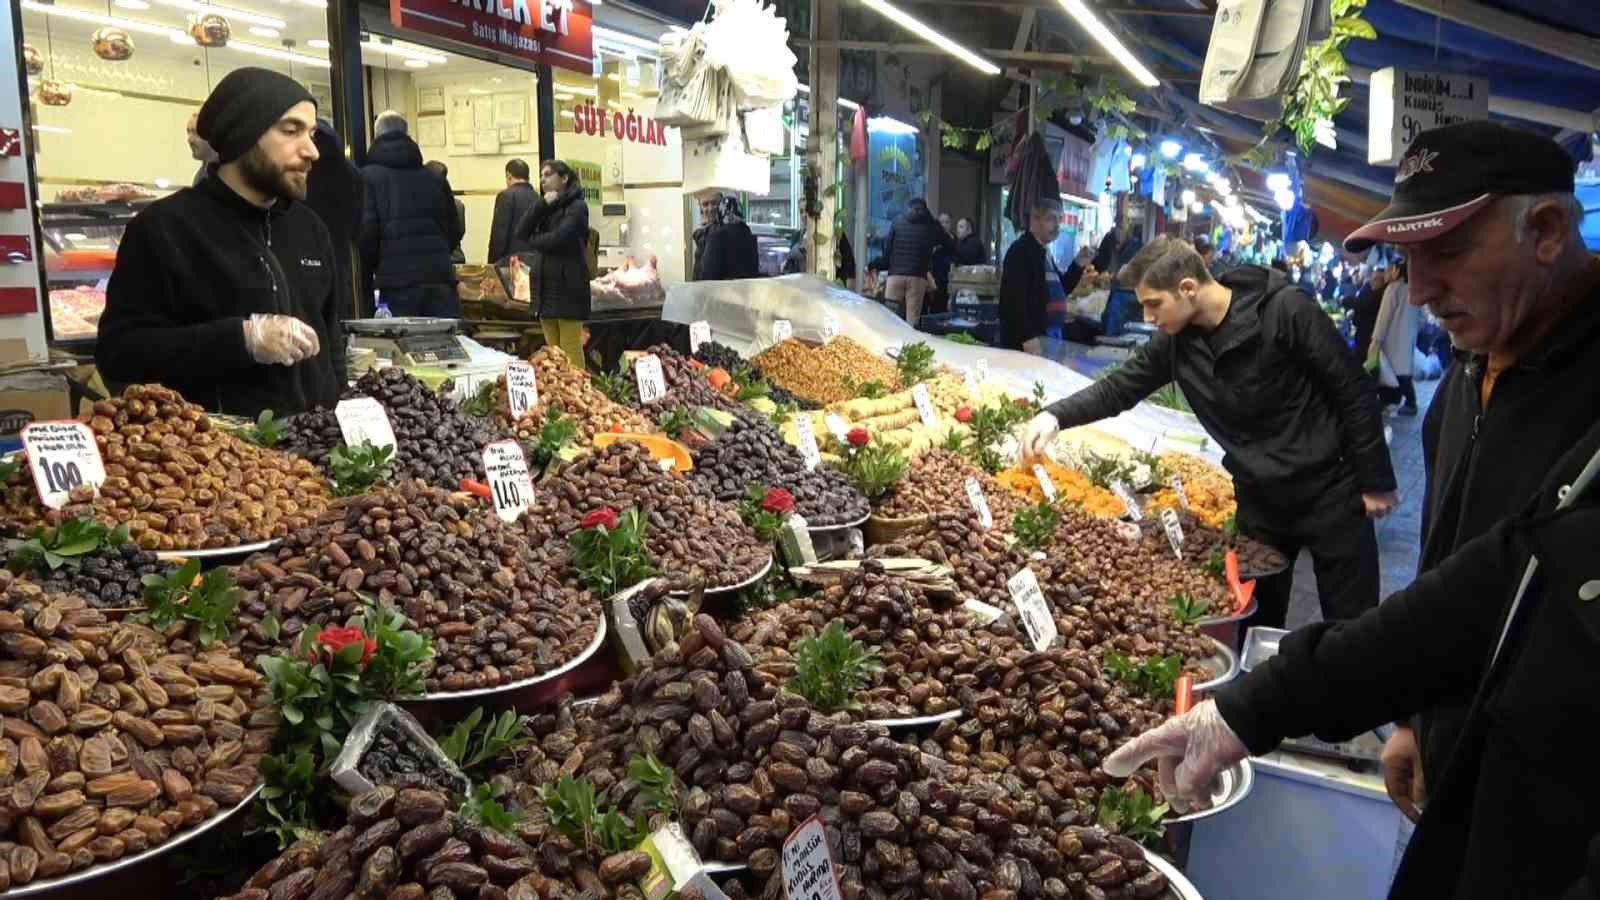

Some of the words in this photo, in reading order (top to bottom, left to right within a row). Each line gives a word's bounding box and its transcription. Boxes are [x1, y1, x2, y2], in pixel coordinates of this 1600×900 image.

[574, 98, 607, 138] SÜT
[613, 106, 667, 146] OĞLAK
[39, 456, 82, 493] 100
[494, 480, 520, 509] 140
